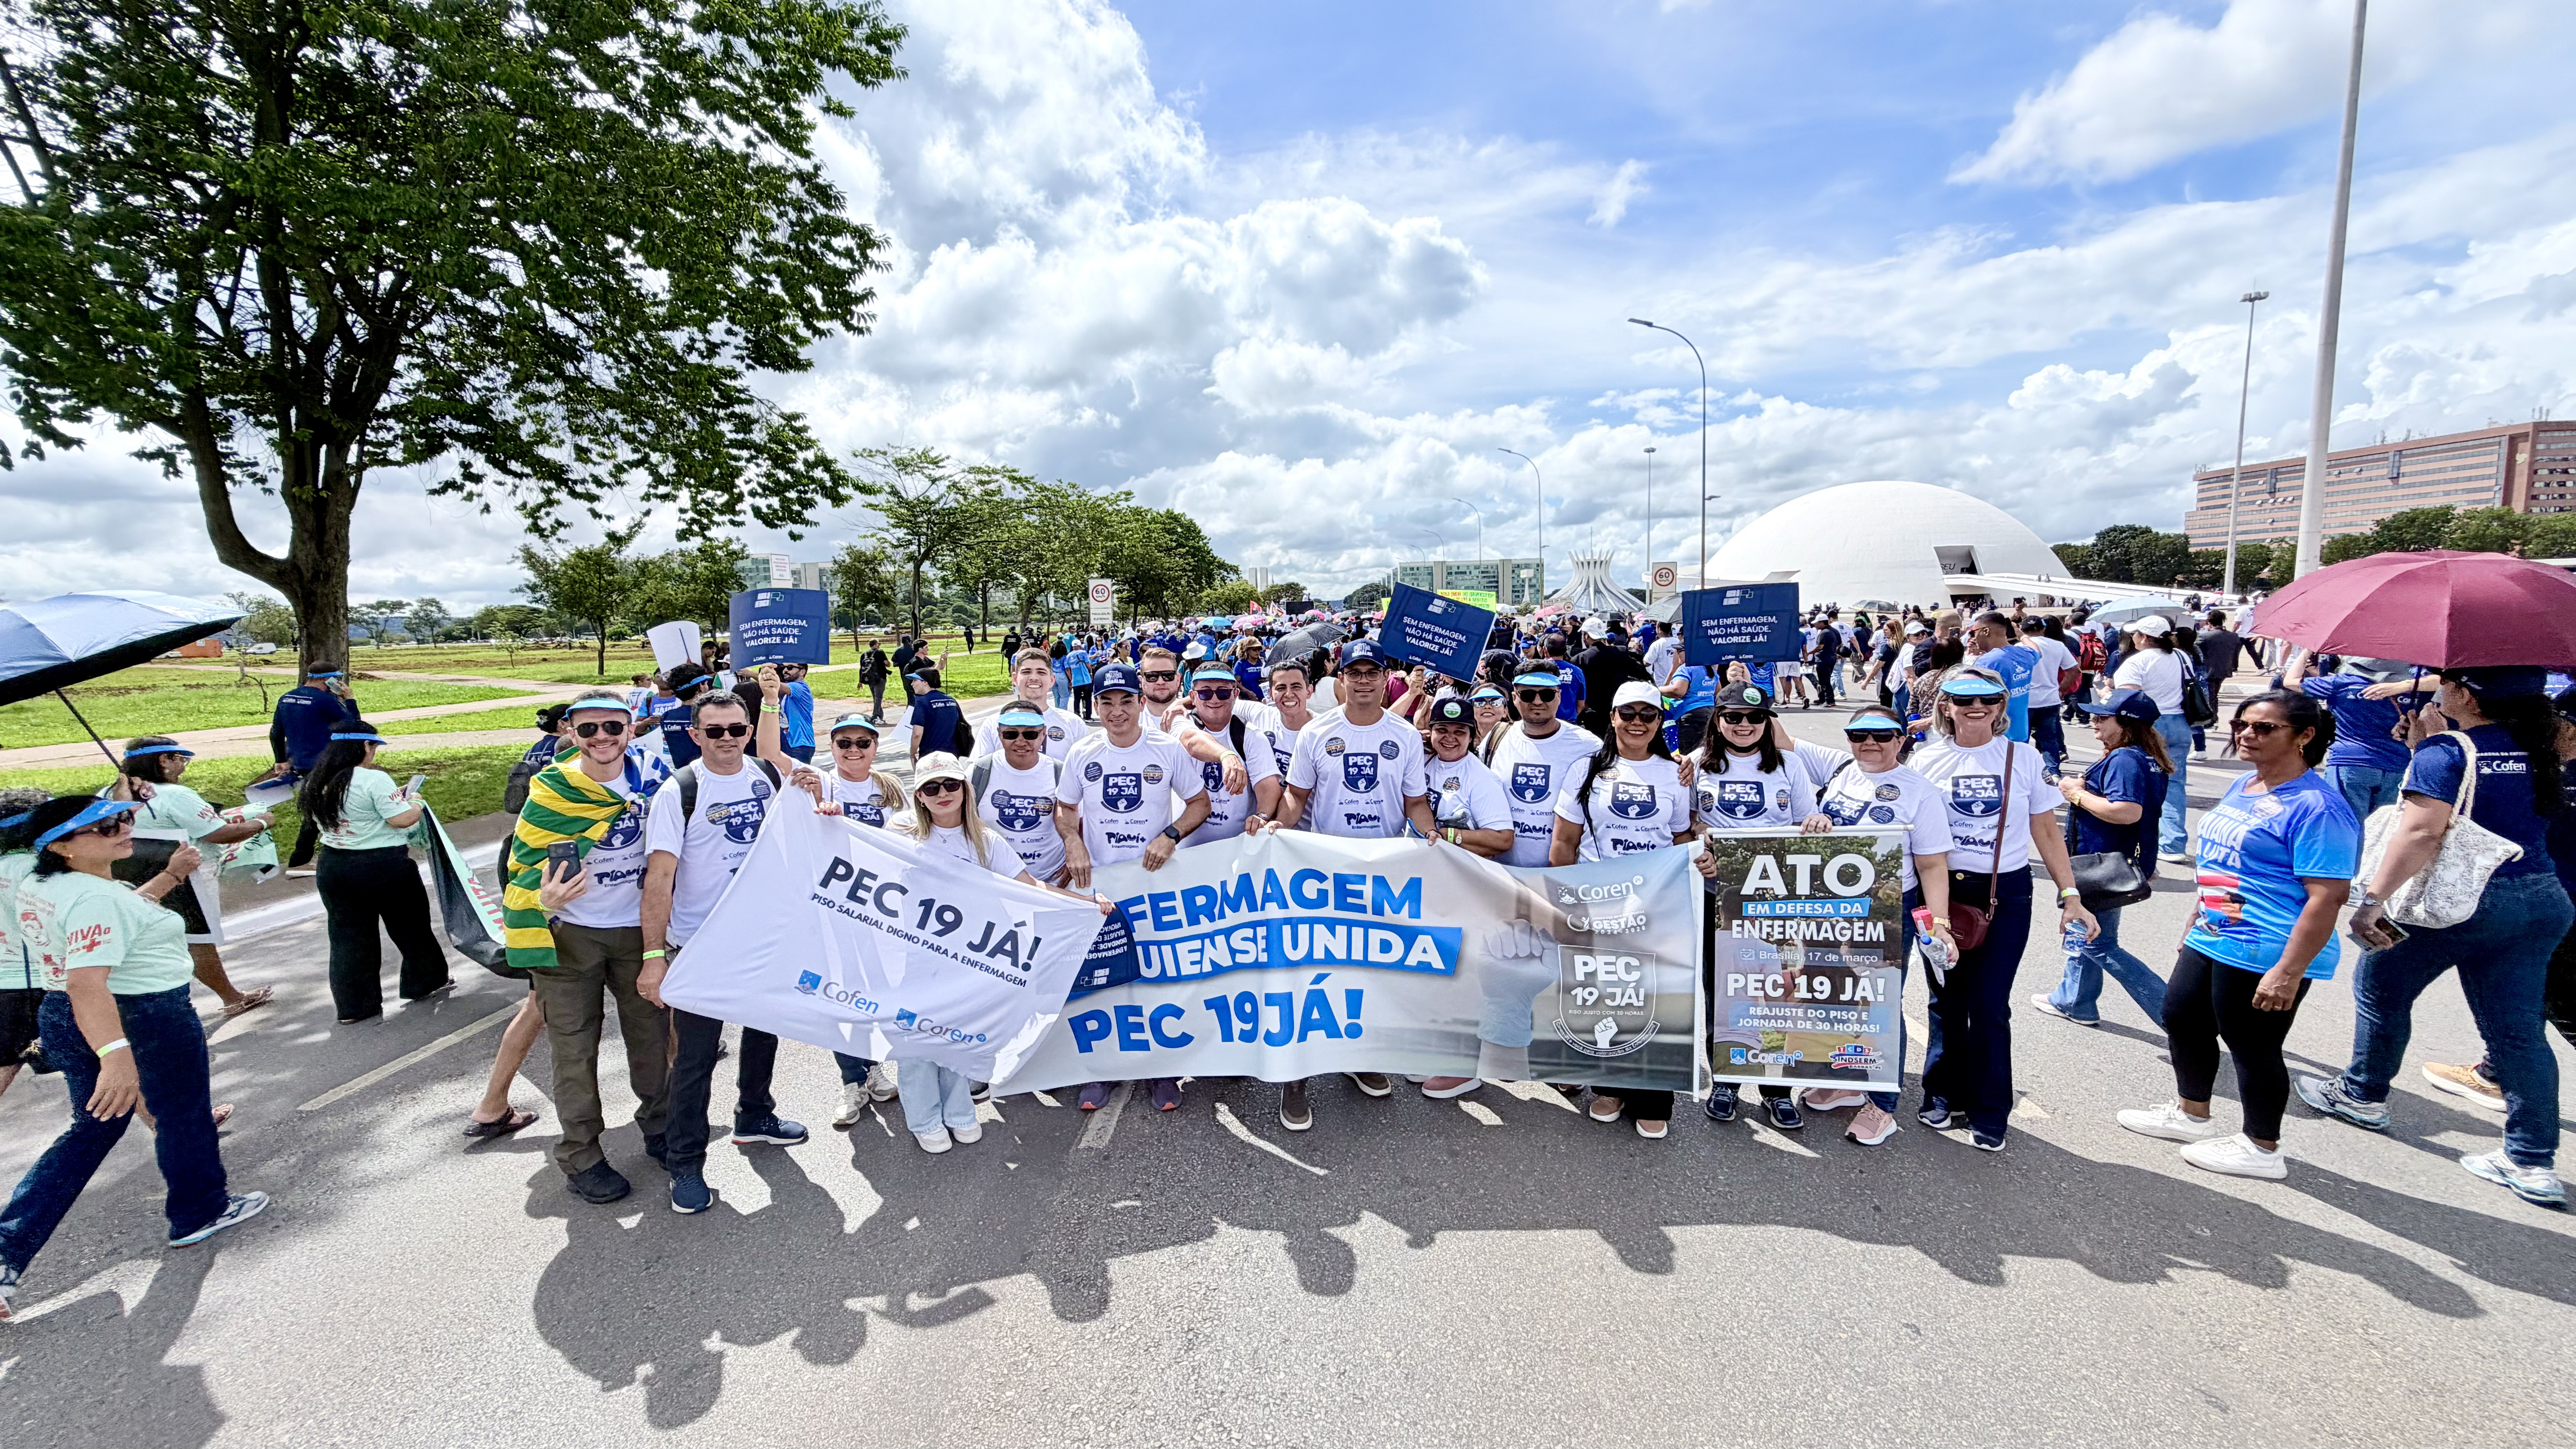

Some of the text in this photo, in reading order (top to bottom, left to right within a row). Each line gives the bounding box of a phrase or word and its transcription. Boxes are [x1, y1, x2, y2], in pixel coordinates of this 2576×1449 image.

[739, 618, 808, 631] SEM ENFERMAGEM,
[1720, 615, 1778, 625] ENFERMAGEM,
[743, 626, 801, 639] NÃO HÁ SAÚDE.
[1403, 616, 1467, 643] SEM ENFERMAGEM,
[1405, 626, 1421, 636] NÃO
[1422, 632, 1433, 640] HÁ
[1708, 624, 1771, 635] NÃO HÁ SAÚDE.
[745, 635, 797, 647] VALORIZE JÁ!
[1711, 634, 1767, 644] VALORIZE JÁ!
[1406, 636, 1453, 656] VALORIZE JÁ!
[1275, 751, 1290, 764] PE
[1348, 755, 1373, 766] PEC
[1361, 765, 1374, 775] JÁ!
[1518, 766, 1545, 777] PEC
[1109, 776, 1136, 786] PEC
[1529, 777, 1546, 786] JÁ!
[1959, 778, 1996, 788] PEC
[1106, 786, 1137, 796] 19 JÁ!
[1619, 784, 1649, 794] PEC
[1725, 783, 1757, 793] PEC
[1976, 788, 1998, 798] JÁ!
[1632, 793, 1651, 802] JÁ!
[1739, 793, 1760, 801] JÁ!
[1834, 794, 1864, 810] PEC
[729, 801, 759, 816] PEC
[1003, 807, 1036, 816] 19 JÁ!
[1828, 803, 1839, 811] 19
[1840, 806, 1859, 818] JÁ!
[614, 817, 635, 830] JÁ!
[729, 811, 762, 826] 19 JÁ!
[1740, 853, 1875, 897] ATO
[1578, 882, 1634, 901] Coren
[819, 856, 1042, 972] PEC 19 JÁ!
[1748, 902, 1863, 914] EM DEFESA DA
[1593, 914, 1646, 930] GESTÃO
[1732, 920, 1885, 942] ENFERMAGEM
[812, 892, 1026, 988] PISO SALARIAL DIGNO PARA A ENFERMAGEM
[1282, 923, 1445, 970] UNIDA
[1759, 951, 1878, 964] Brasília, 17 de março
[1574, 955, 1641, 981] PEC
[1727, 970, 1886, 1002] PEC 19 JÁ!
[823, 982, 879, 1014] Cofen
[1571, 982, 1645, 1007] 19 JÁ!
[1749, 1006, 1868, 1020] REAJUSTE DO PISO E
[917, 1018, 974, 1044] Coren
[1068, 1003, 1195, 1053] PEC
[1737, 1017, 1880, 1033] JORNADA DE 30 HORAS!
[1748, 1049, 1795, 1065] Coren
[1833, 1056, 1877, 1064] SINDSERM
